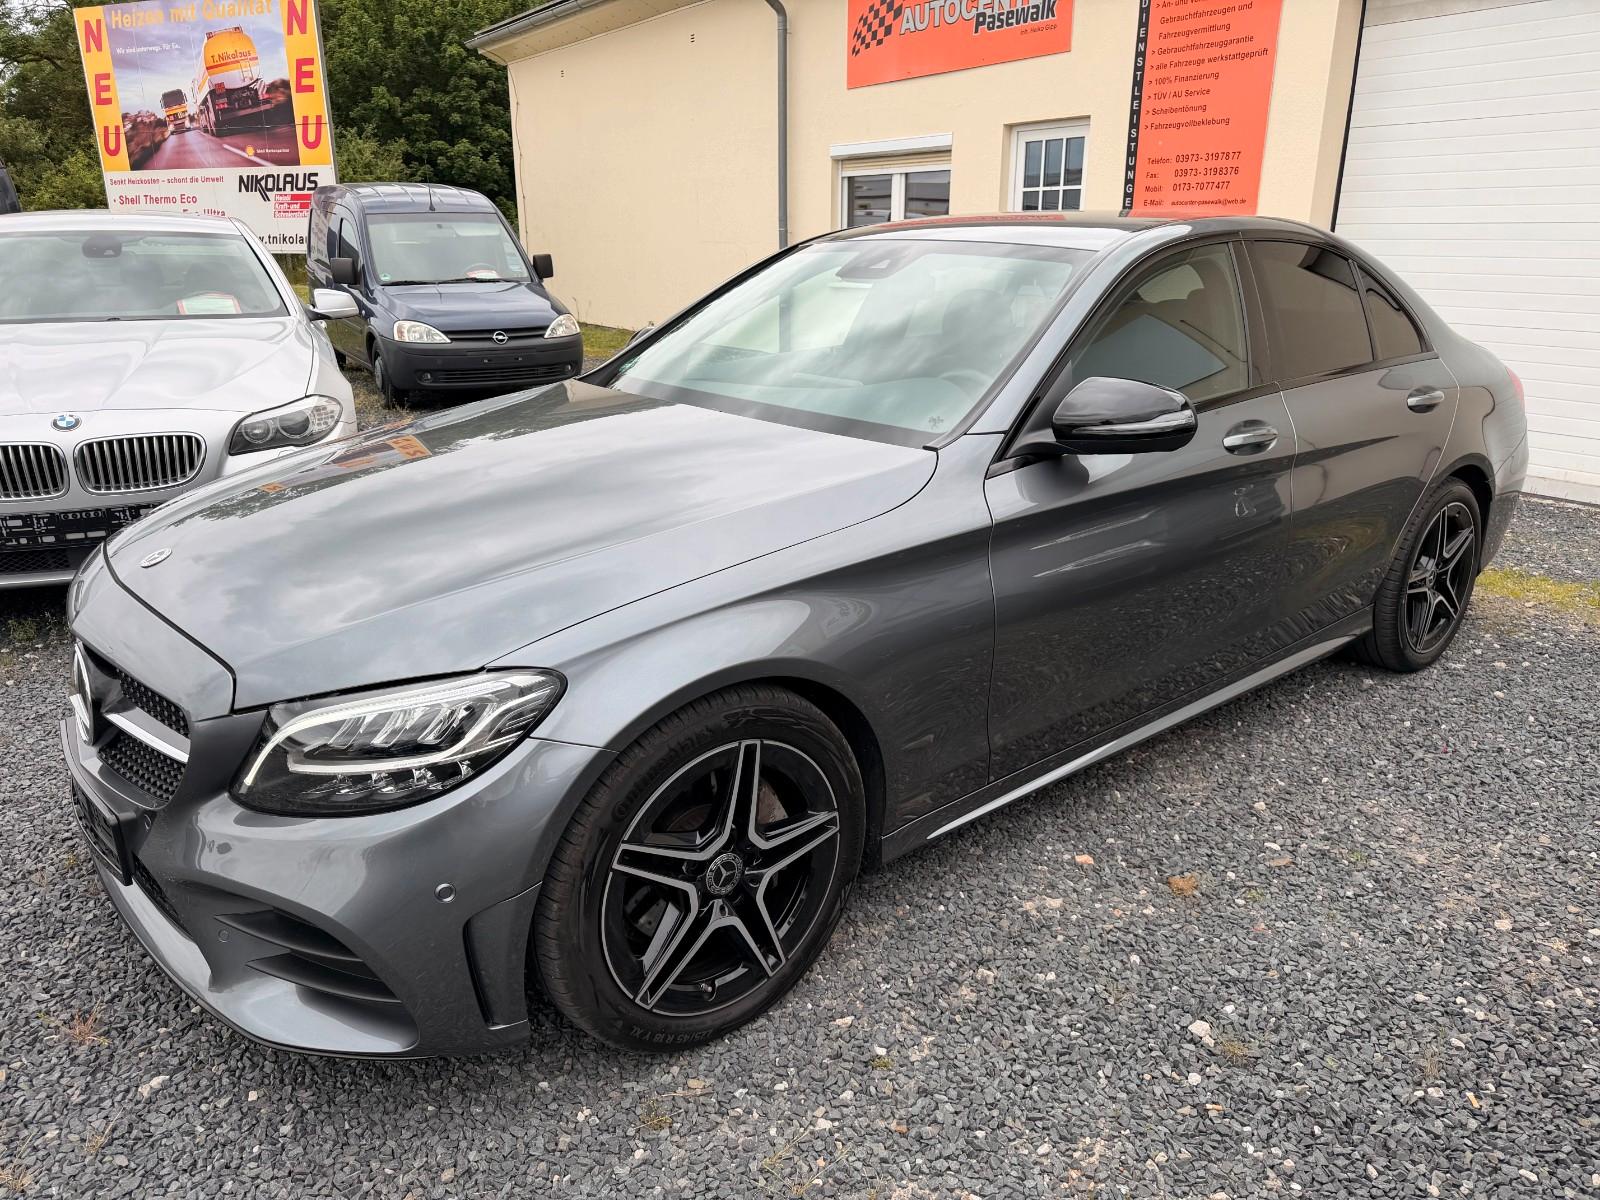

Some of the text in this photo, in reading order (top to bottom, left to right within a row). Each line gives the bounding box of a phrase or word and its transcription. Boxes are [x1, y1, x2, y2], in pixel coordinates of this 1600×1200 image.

[111, 10, 164, 29] Heizen
[169, 6, 196, 23] mit
[974, 0, 1057, 34] Pasewalk
[1160, 3, 1253, 24] Gebrauchtfahrzeugen und
[1158, 23, 1231, 40] Fahrzeugvermittlung
[1157, 35, 1254, 56] Gebrauchtfahrzeuggarantie
[1155, 47, 1269, 71] alle Fahrzeuge werkstattgeprüft
[1154, 71, 1220, 86] 100% Finanzierung
[1153, 91, 1168, 101] TÜV
[1172, 90, 1183, 99] AU
[1184, 88, 1211, 98] Service
[1151, 103, 1207, 116] Scheibentönung
[1150, 117, 1230, 131] Fahrzeugvollbeklebung
[167, 176, 188, 184] schont
[201, 175, 224, 183] Umwelt
[238, 172, 319, 201] NIKOLAUS
[1172, 180, 1231, 192] 0173-7077477
[119, 194, 197, 205] Shell Thermo Eco
